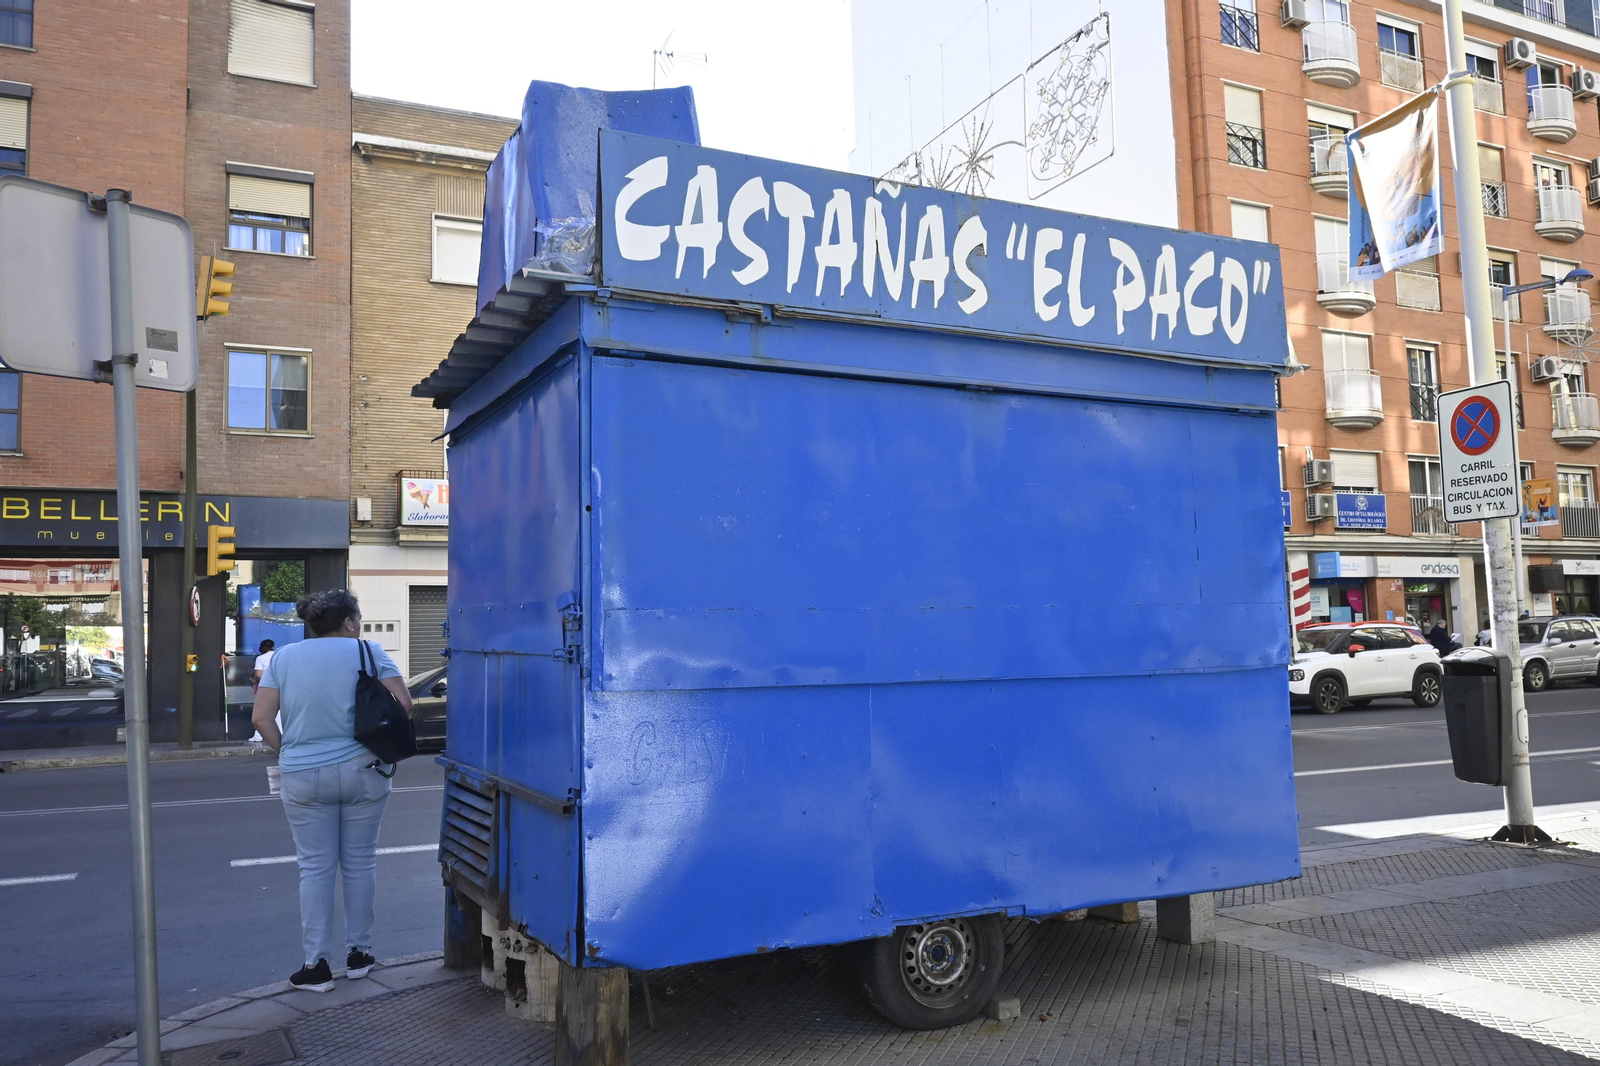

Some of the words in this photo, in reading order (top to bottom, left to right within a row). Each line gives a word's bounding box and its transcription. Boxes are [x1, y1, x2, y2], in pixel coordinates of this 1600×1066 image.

[615, 156, 988, 315] CASTAÑAS
[1005, 221, 1096, 327] "EL
[1108, 236, 1271, 345] PACO"
[1460, 459, 1496, 473] CARRIL
[1450, 472, 1508, 488] RESERVADO
[1447, 486, 1514, 503] CIRCULACION
[2, 496, 230, 523] BELLERN
[1453, 504, 1473, 515] BUS
[1476, 503, 1482, 512] Y
[1421, 561, 1459, 574] endesa
